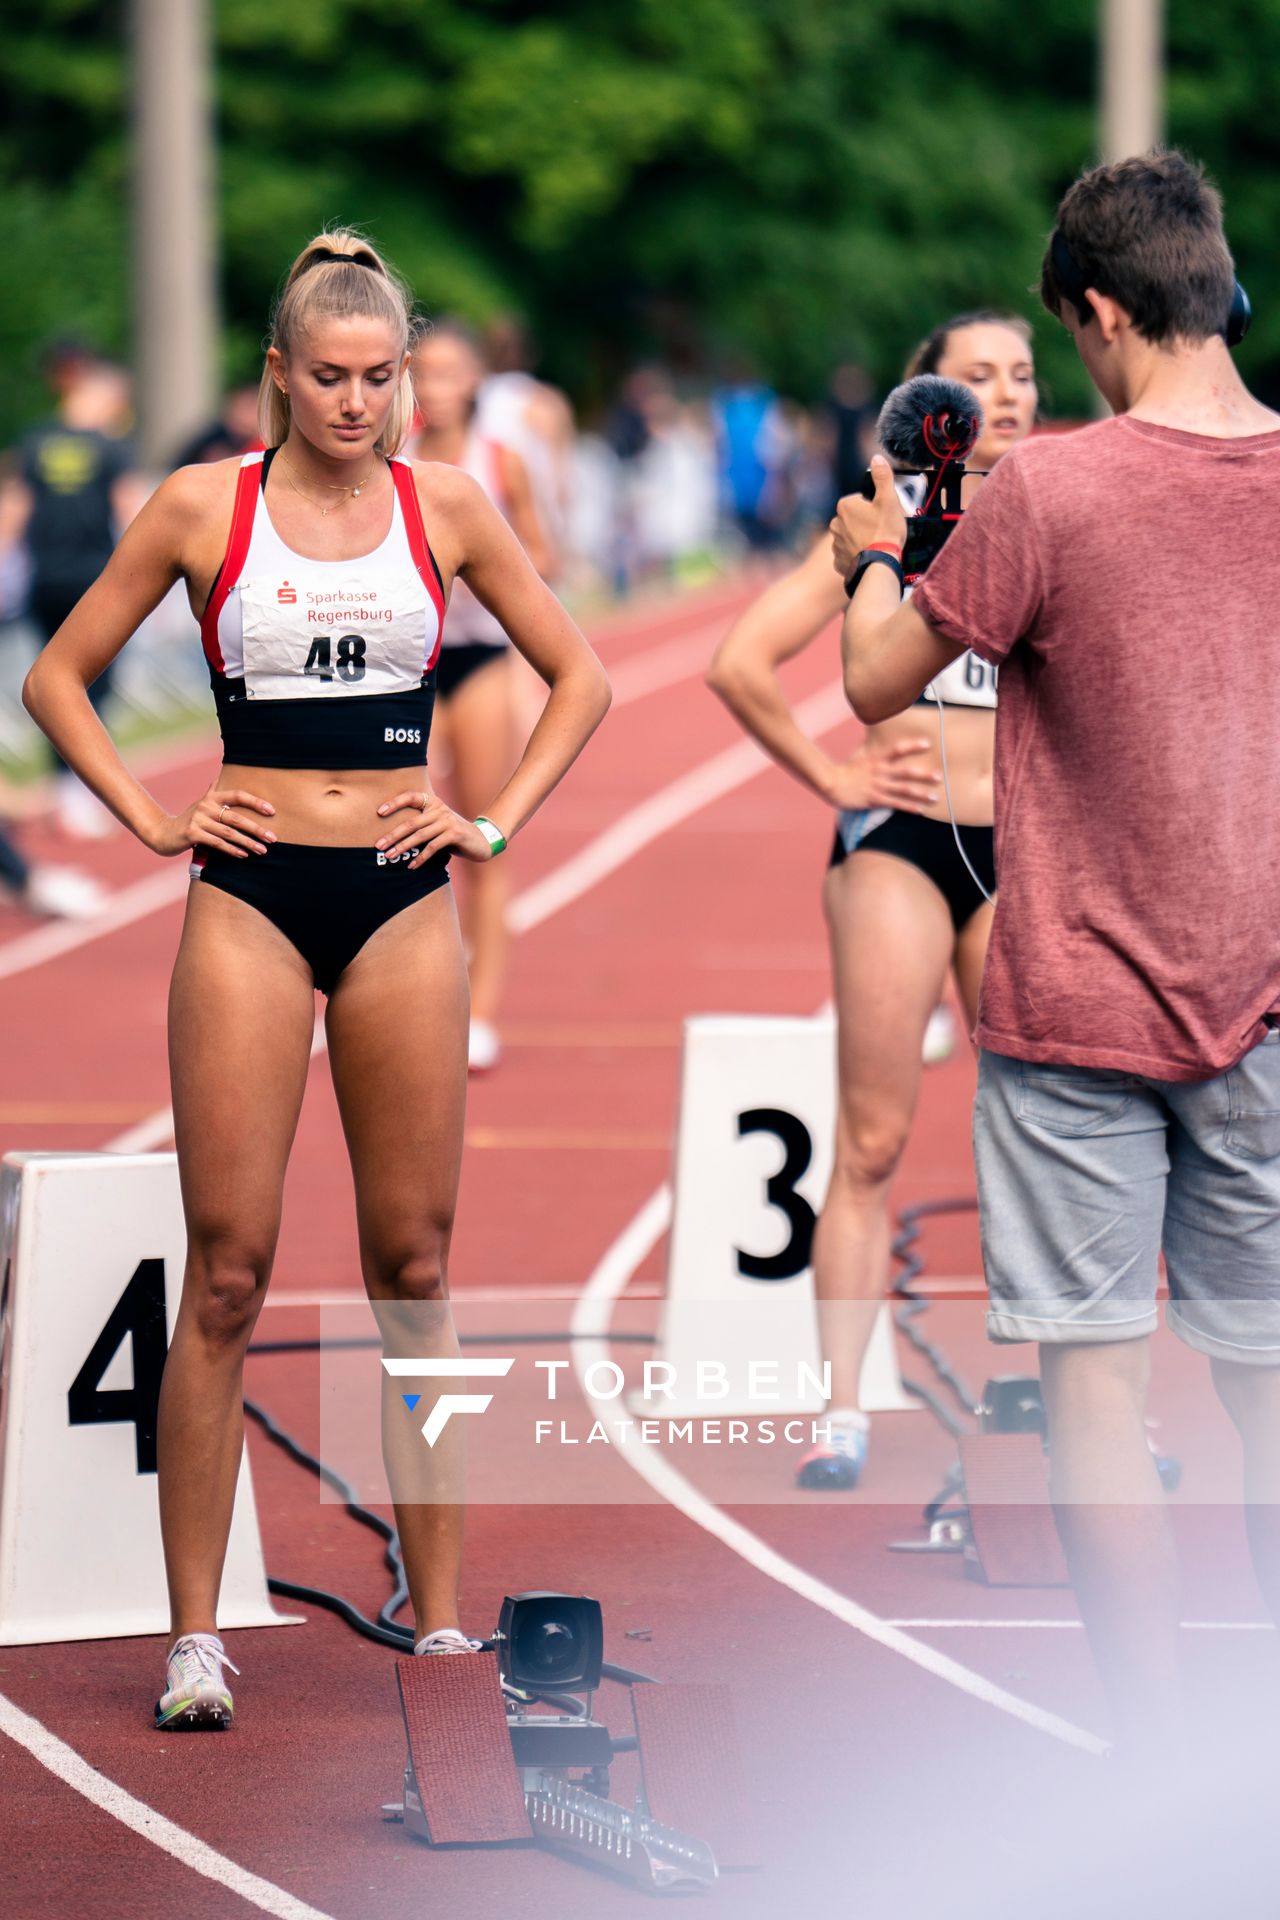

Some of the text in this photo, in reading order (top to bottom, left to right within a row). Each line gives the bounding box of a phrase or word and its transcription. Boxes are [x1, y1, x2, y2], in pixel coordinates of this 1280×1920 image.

[306, 590, 377, 606] Sparkasse
[308, 608, 392, 625] Regensburg
[304, 634, 367, 684] 48
[965, 651, 997, 693] 6
[384, 727, 421, 745] BOSS
[736, 1108, 818, 1281] 3
[67, 1257, 168, 1475] 4
